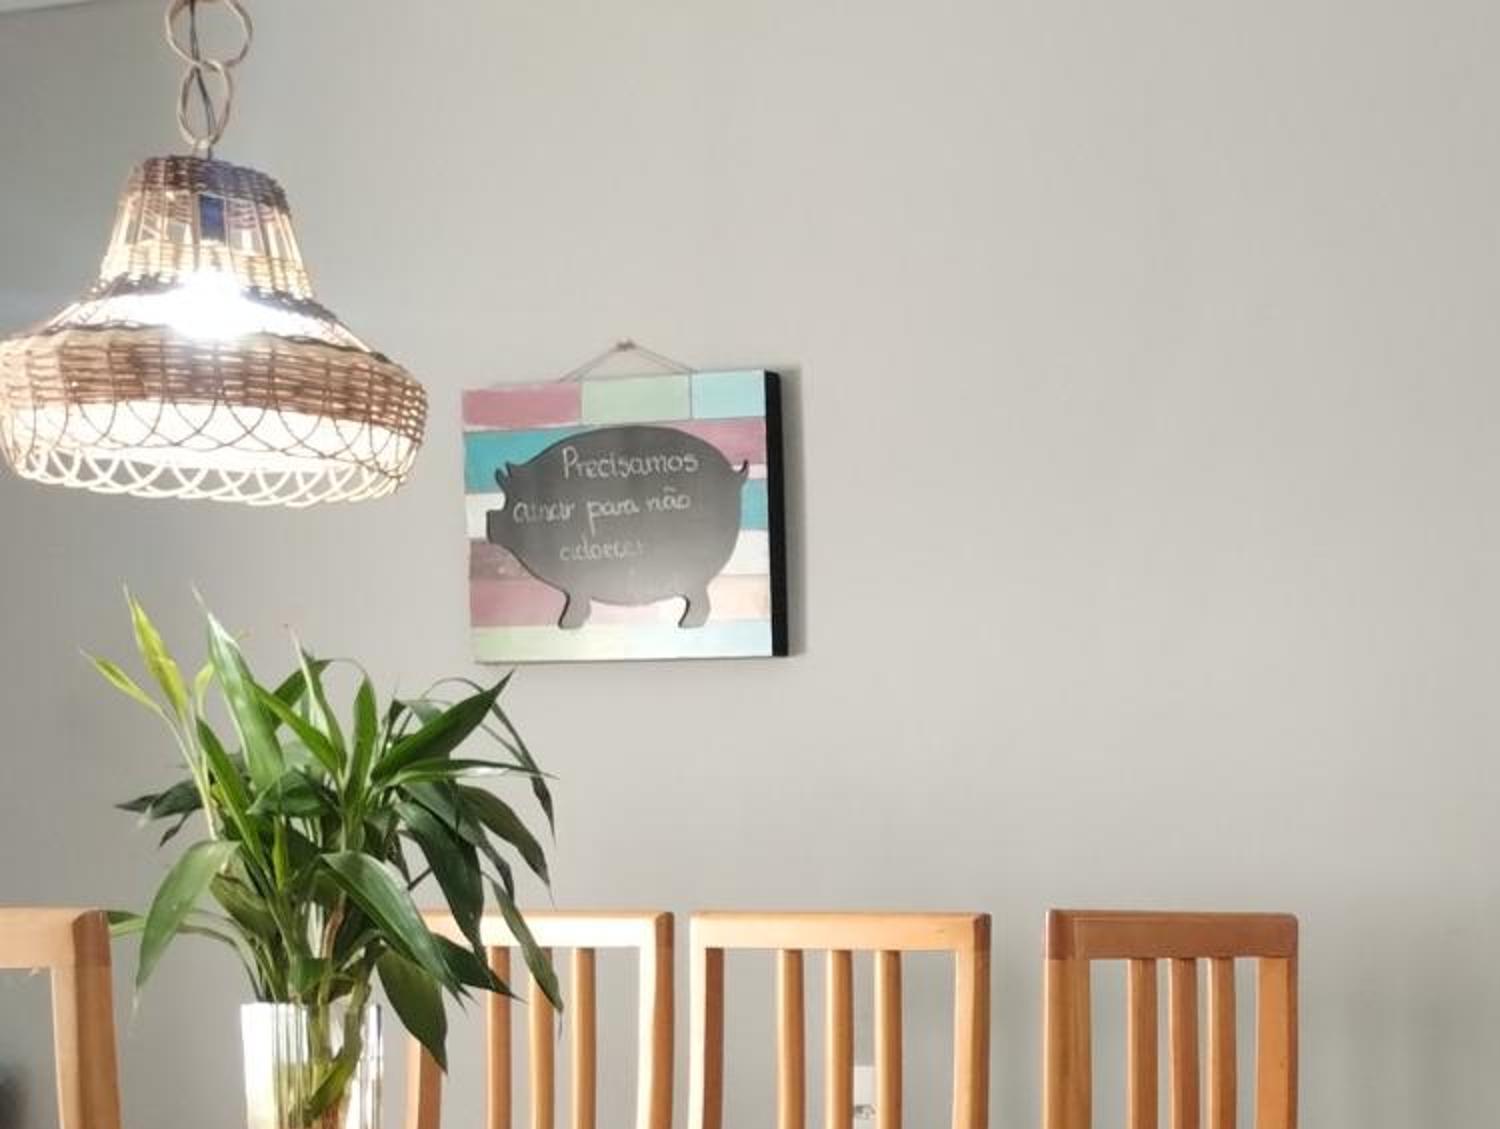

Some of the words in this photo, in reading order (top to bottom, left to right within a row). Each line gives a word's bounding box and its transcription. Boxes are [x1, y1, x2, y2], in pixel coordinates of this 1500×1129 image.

[562, 445, 701, 480] Precisamos
[586, 498, 640, 537] para
[645, 485, 692, 512] não
